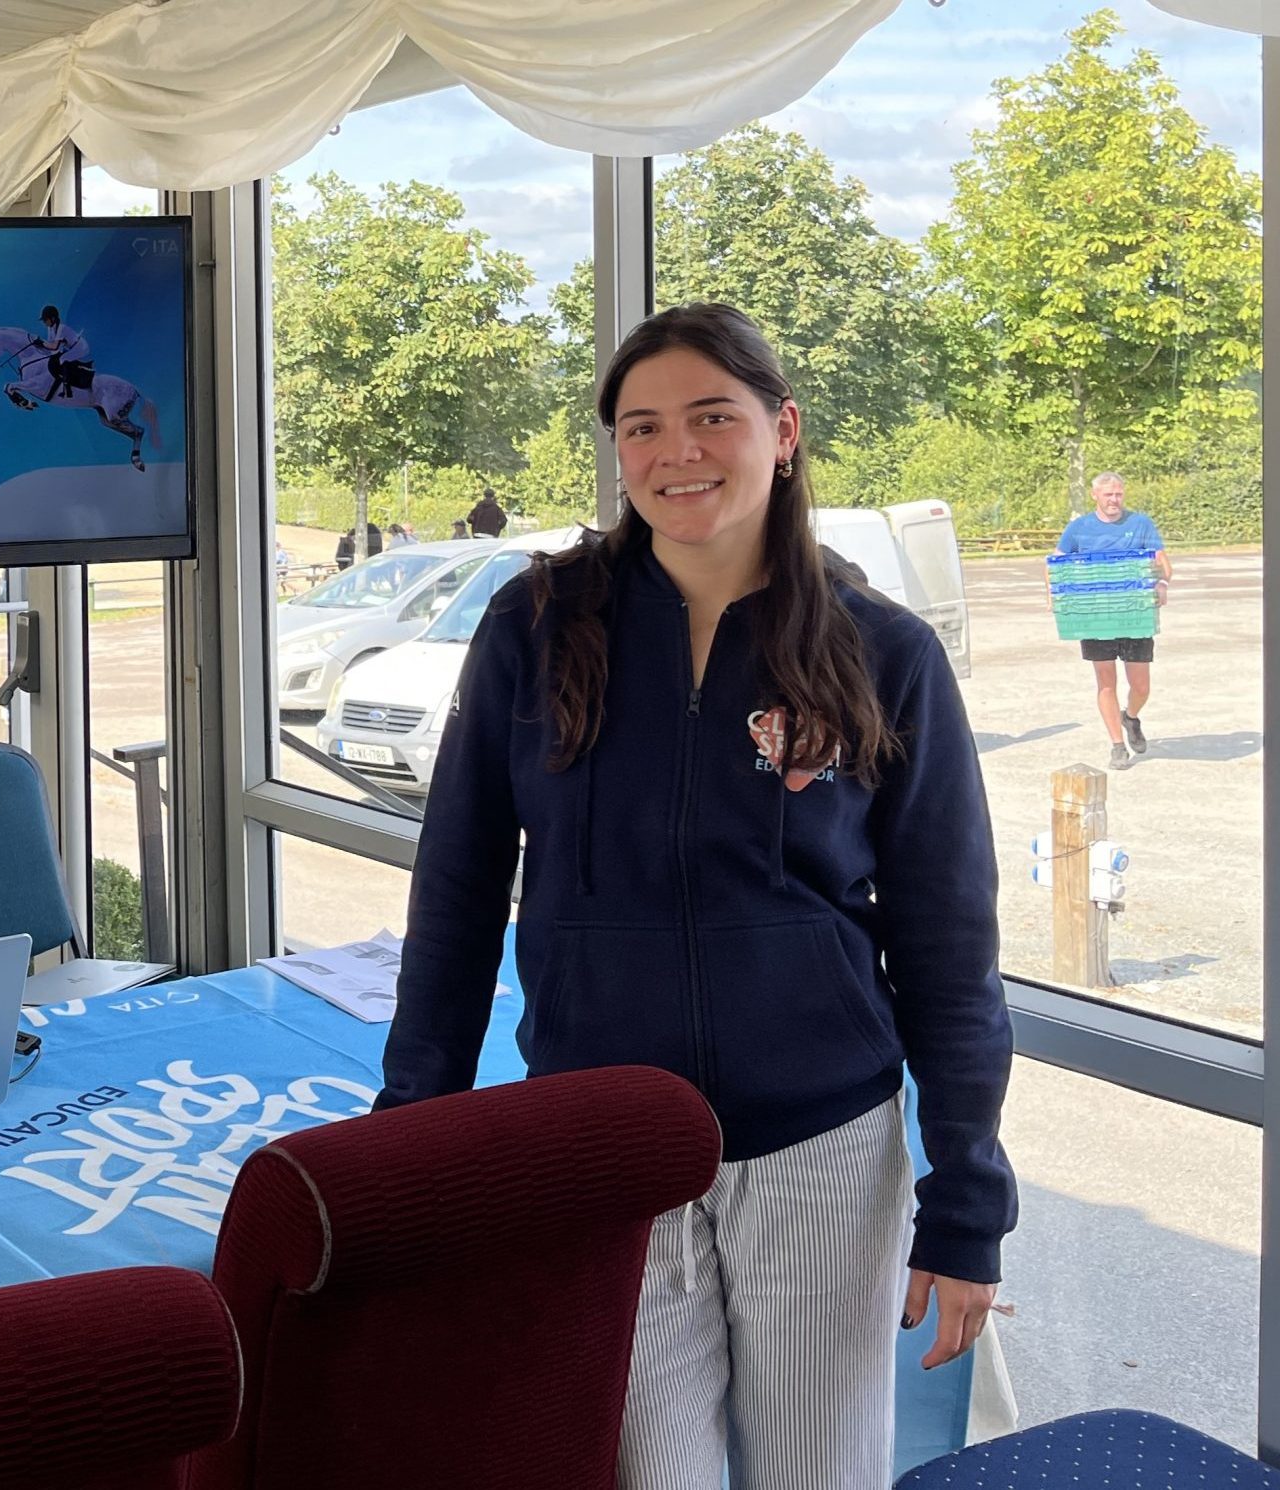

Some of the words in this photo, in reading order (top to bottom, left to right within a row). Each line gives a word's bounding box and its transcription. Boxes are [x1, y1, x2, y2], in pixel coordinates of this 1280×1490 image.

[152, 239, 179, 255] ITA
[755, 758, 835, 782] EDOR
[108, 996, 165, 1012] ITA
[0, 1059, 261, 1236] SPORT
